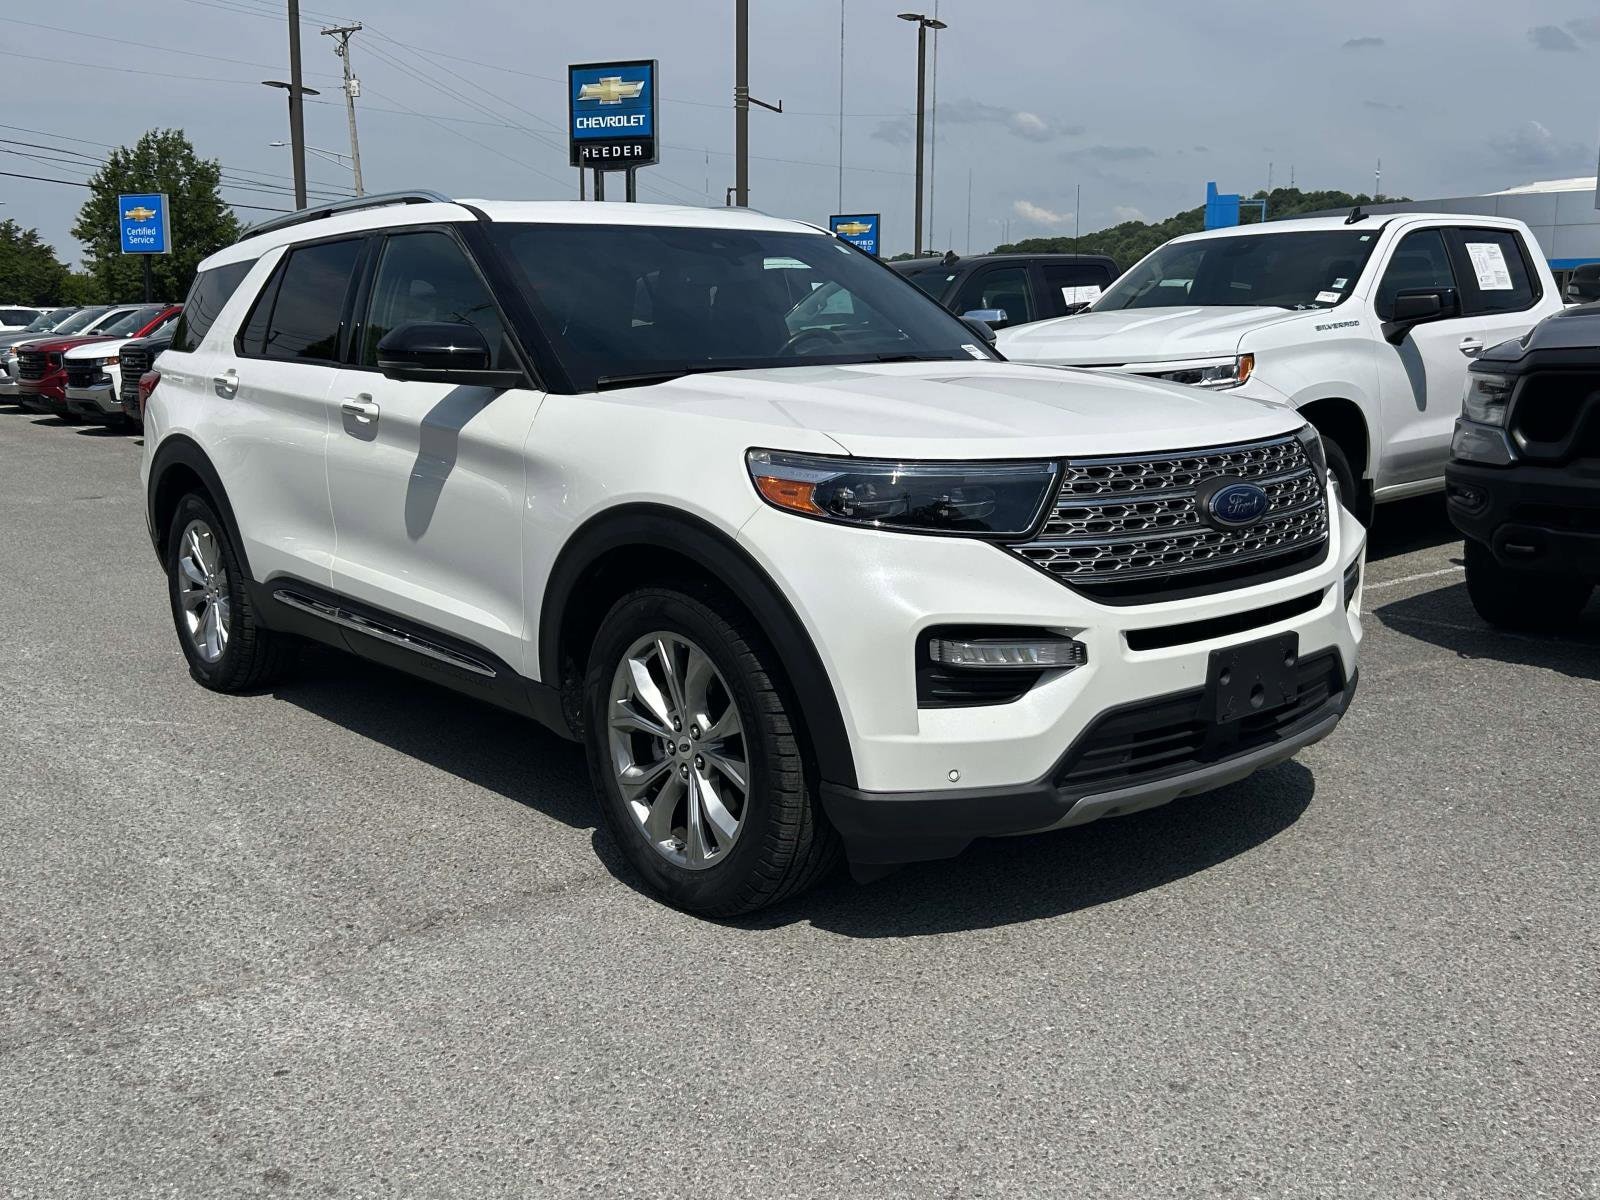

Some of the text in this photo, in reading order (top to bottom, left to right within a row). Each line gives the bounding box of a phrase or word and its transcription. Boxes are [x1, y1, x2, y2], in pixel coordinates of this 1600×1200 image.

[576, 115, 645, 128] CHEVROLET
[582, 145, 642, 158] REEDER
[126, 227, 156, 235] Certified
[129, 236, 155, 244] Service
[1315, 320, 1360, 331] SILVERADO
[1227, 492, 1258, 513] Ford
